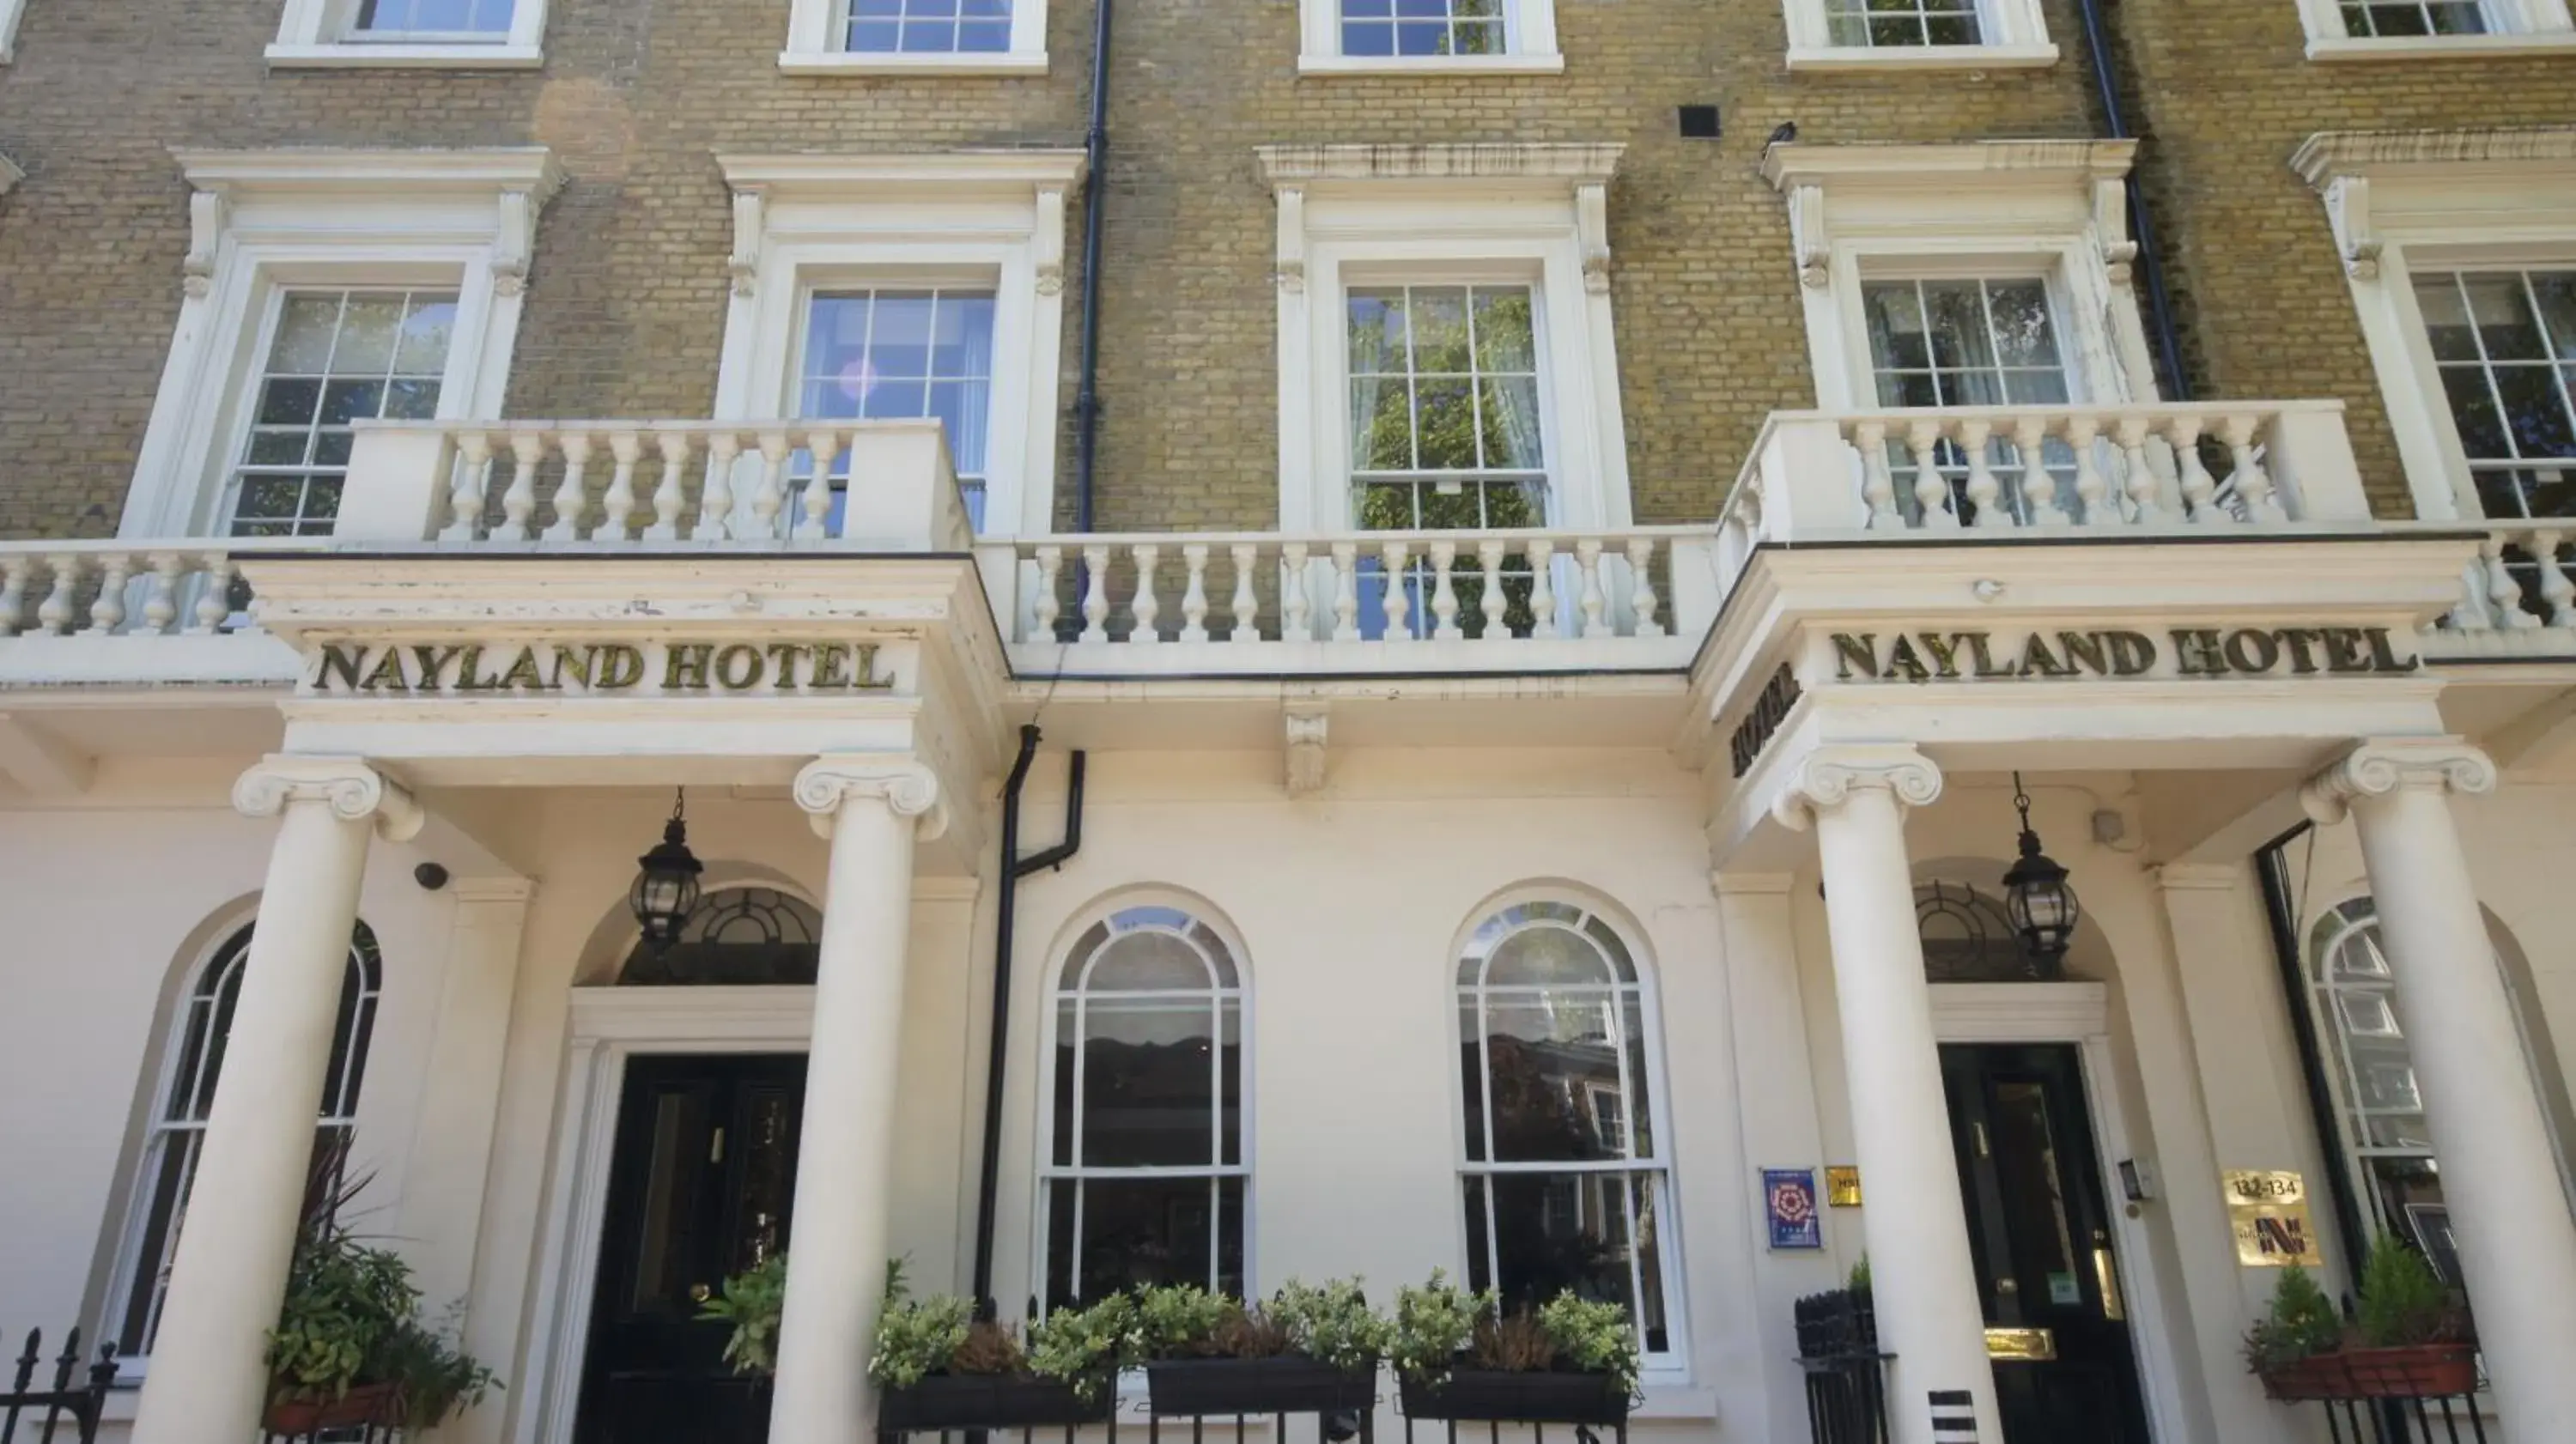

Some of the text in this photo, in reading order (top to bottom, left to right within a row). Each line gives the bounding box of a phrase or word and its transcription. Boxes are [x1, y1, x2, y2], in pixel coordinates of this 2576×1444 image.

[313, 643, 896, 689] NAYLAND HOTEL
[1830, 627, 2418, 683] NAYLAND HOTEL
[2234, 1176, 2297, 1198] 132-134
